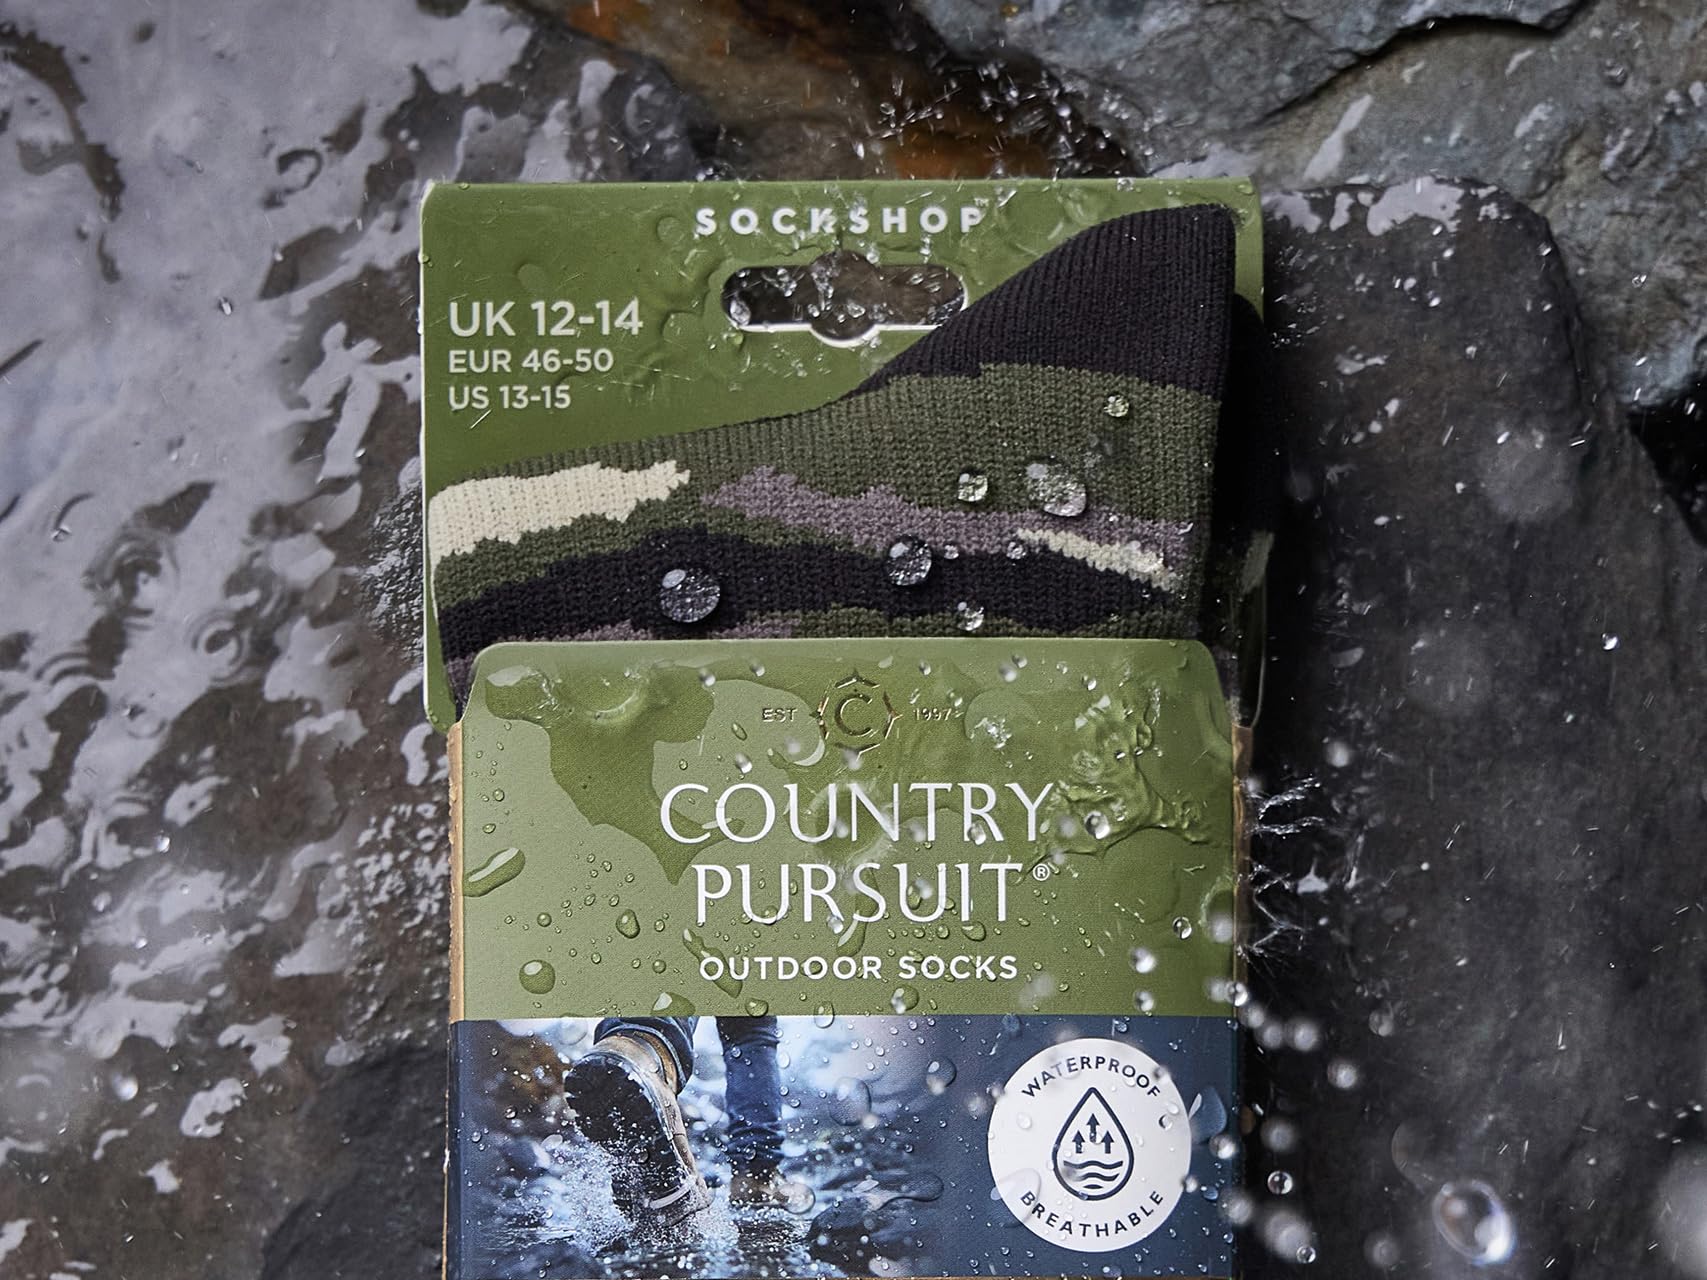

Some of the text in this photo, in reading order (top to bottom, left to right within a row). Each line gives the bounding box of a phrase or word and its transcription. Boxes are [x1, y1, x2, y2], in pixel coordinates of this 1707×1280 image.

[449, 300, 644, 337] UK 12-14
[449, 348, 614, 373] EUR 46-50
[449, 385, 572, 410] US 13-15
[761, 707, 798, 723] EST
[912, 707, 952, 721] 1997
[660, 782, 1054, 844] COUNTRY
[699, 954, 1018, 981] OUTDOOR SOCKS
[1021, 1055, 1161, 1098] WATERPROOF
[1020, 1190, 1164, 1238] BREATHABLE
